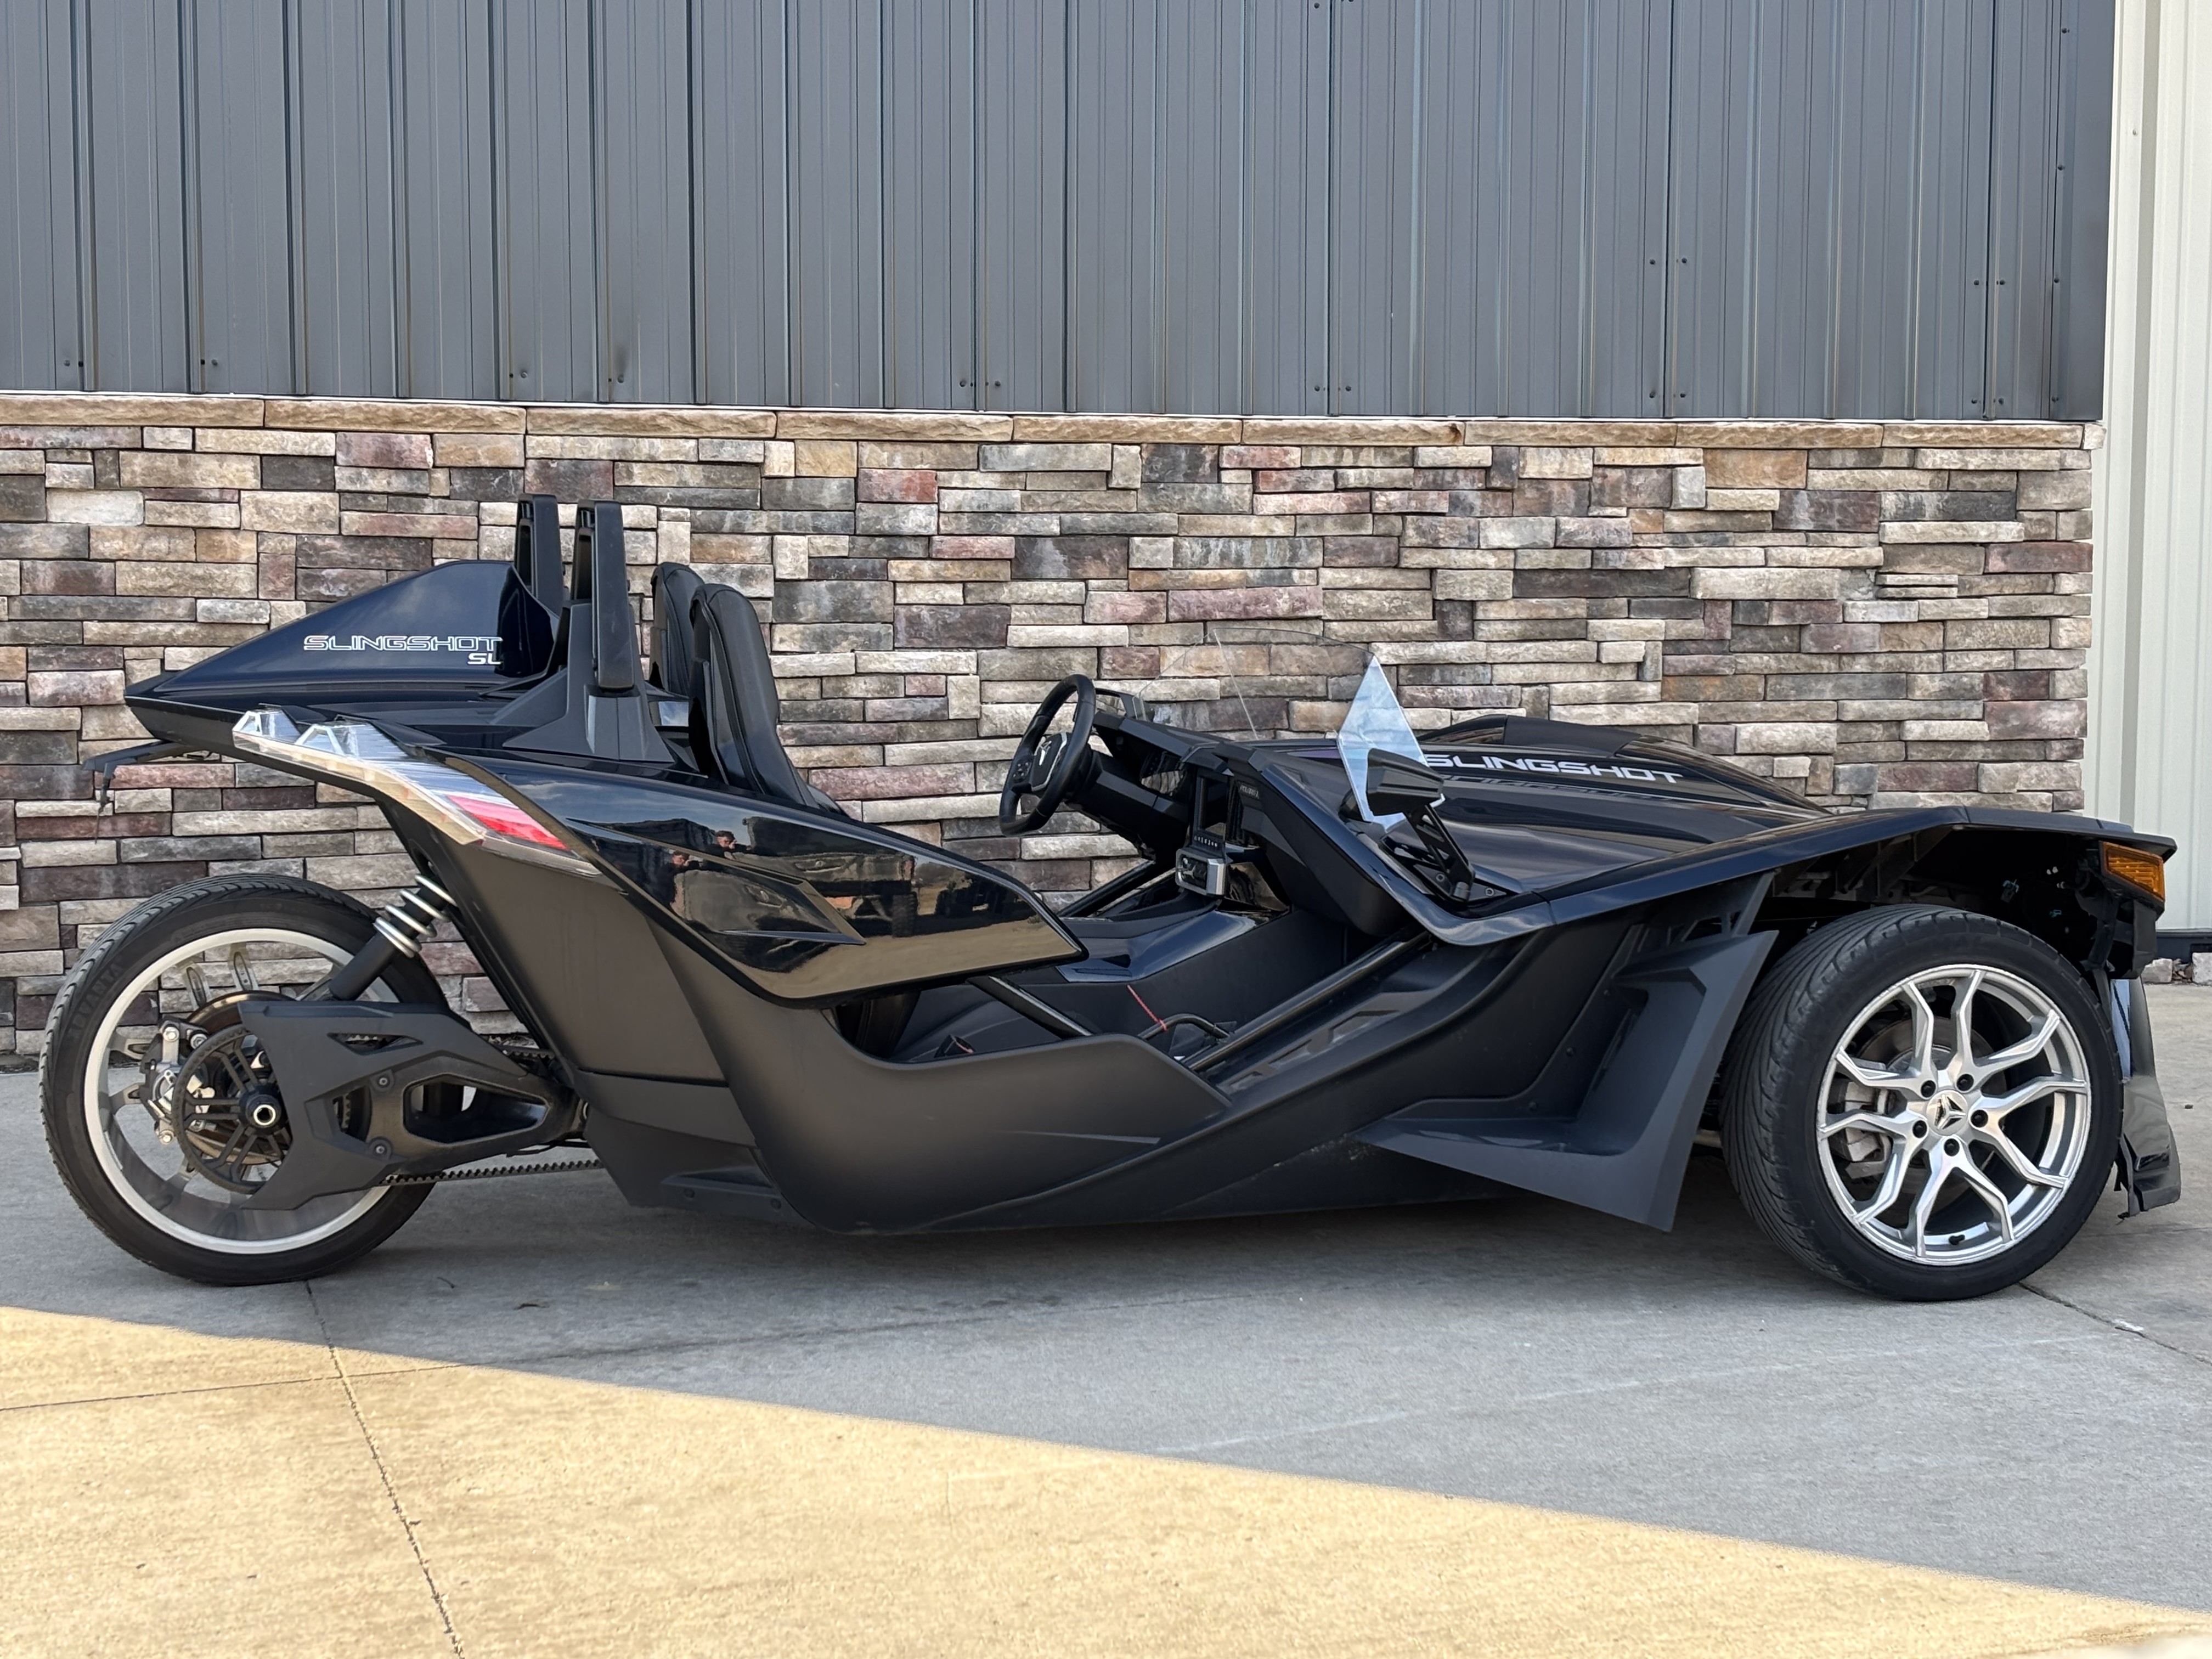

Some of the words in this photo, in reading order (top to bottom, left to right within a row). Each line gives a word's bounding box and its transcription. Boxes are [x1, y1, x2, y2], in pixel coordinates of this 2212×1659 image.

[303, 635, 503, 652] SLINGSHOT
[467, 653, 502, 664] SL
[1424, 754, 1684, 783] SLINGSHOT
